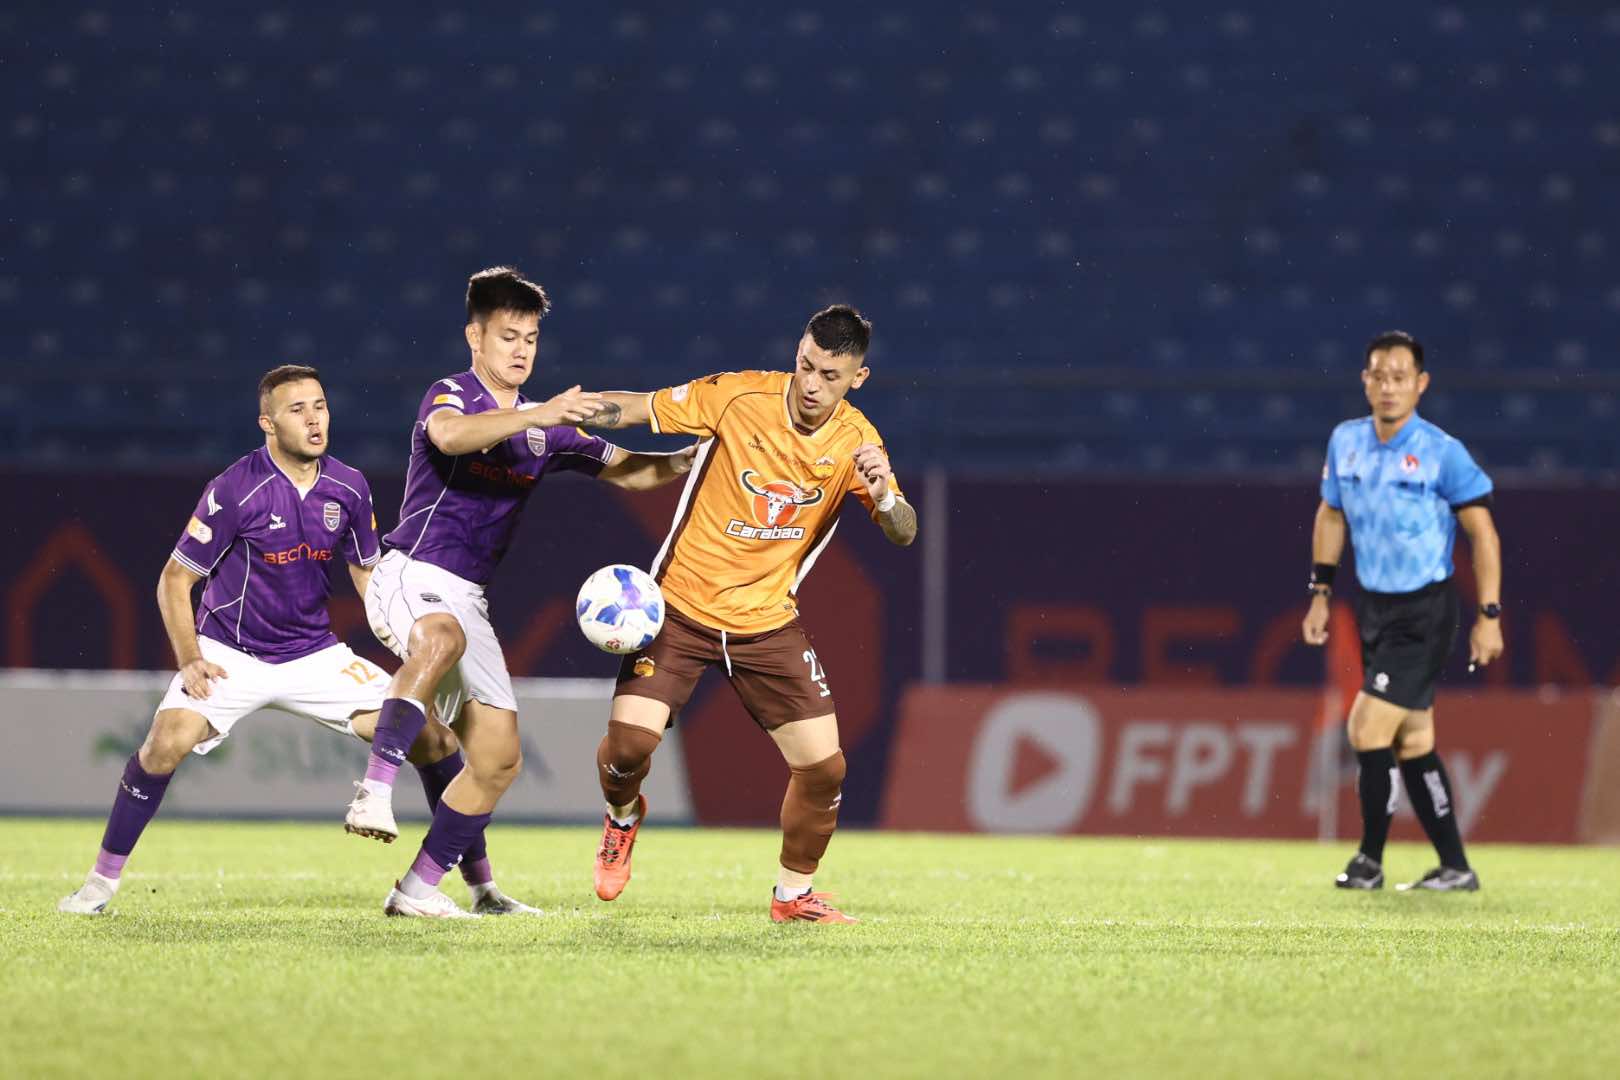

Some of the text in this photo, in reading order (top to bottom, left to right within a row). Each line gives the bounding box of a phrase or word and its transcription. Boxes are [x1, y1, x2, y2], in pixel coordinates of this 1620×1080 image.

[725, 518, 806, 541] Carabao
[341, 661, 378, 684] 12
[803, 647, 825, 681] 2
[1107, 721, 1297, 816] FPT
[1304, 722, 1506, 836] Py
